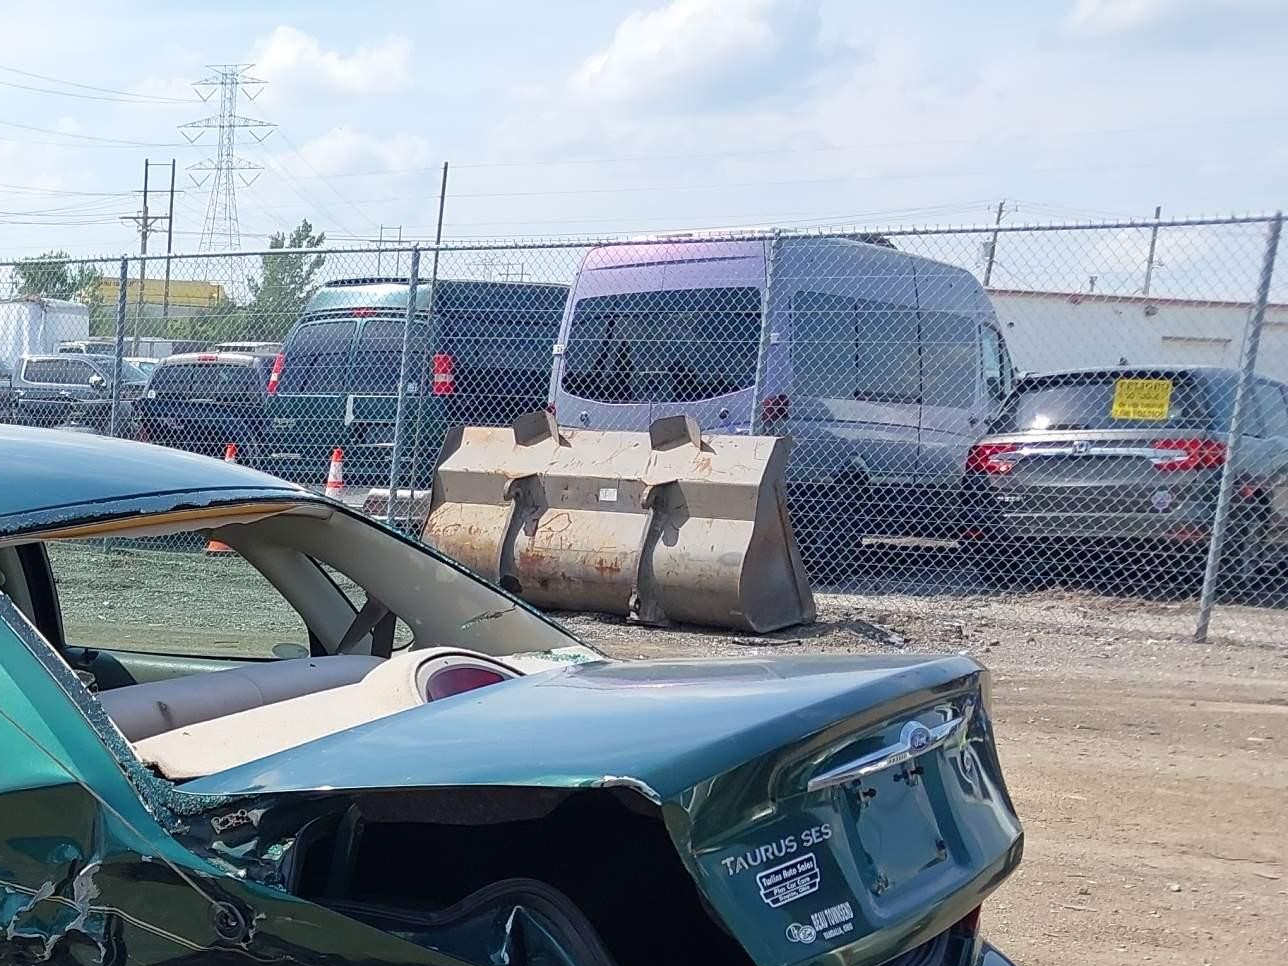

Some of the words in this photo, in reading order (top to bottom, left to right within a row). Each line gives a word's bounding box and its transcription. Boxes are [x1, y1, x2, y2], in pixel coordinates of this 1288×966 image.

[721, 836, 798, 876] TAURUS
[801, 823, 832, 847] SES
[782, 867, 797, 879] Auto
[797, 860, 813, 873] Sales
[811, 911, 829, 932] BEAU
